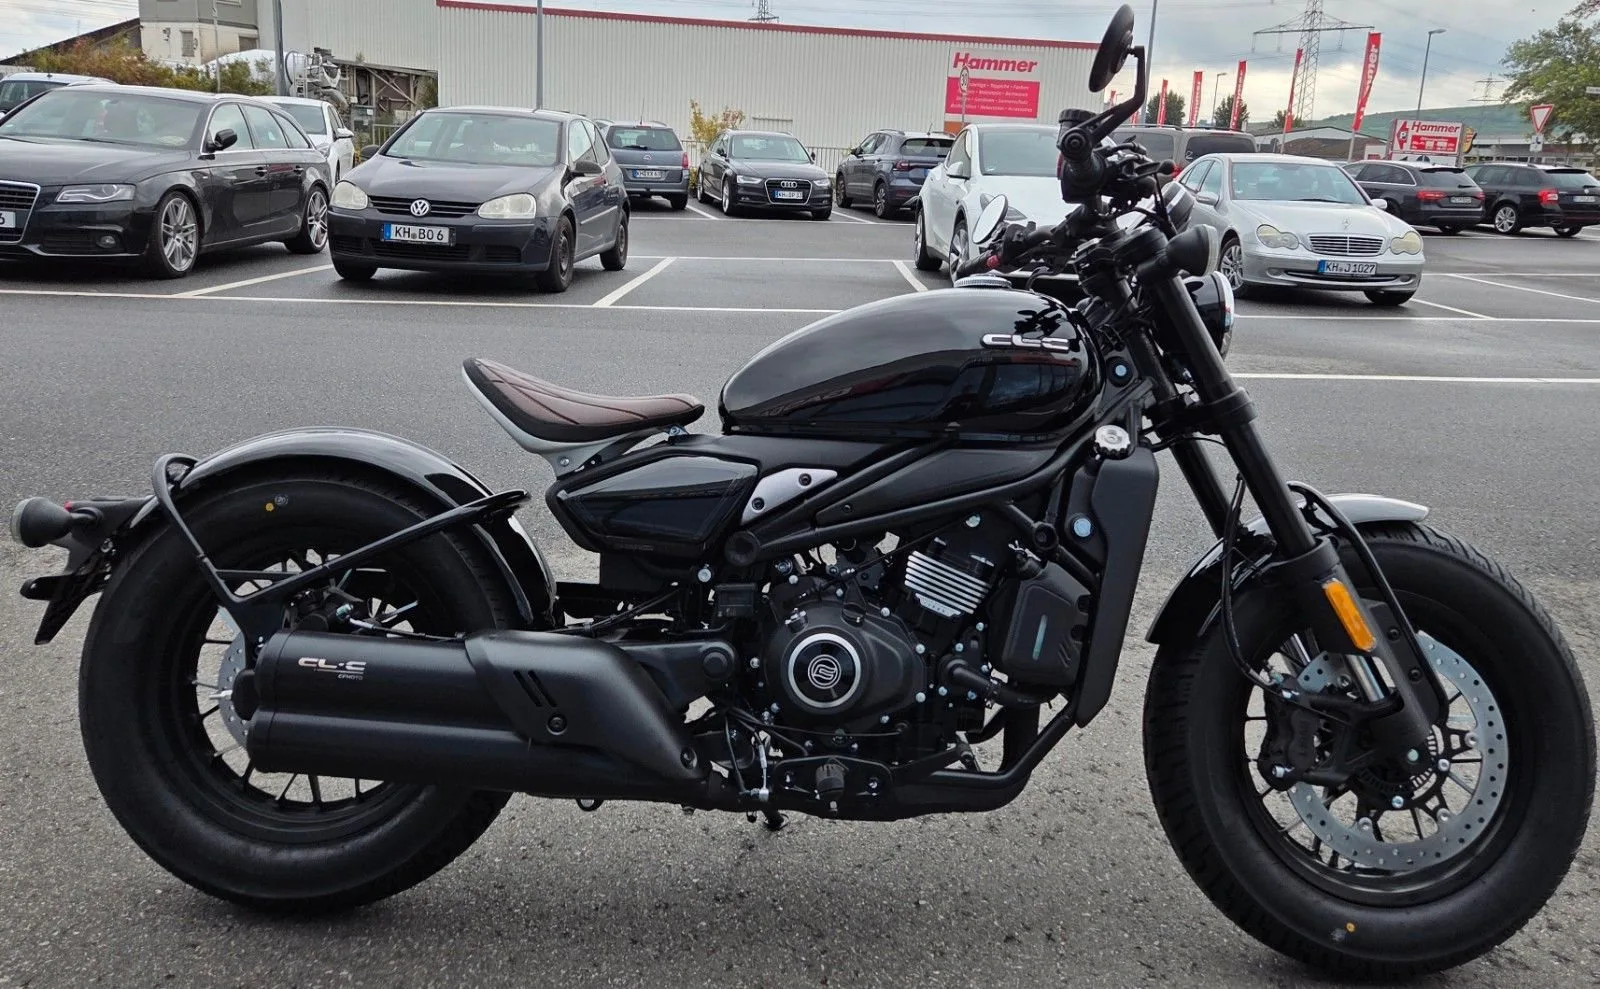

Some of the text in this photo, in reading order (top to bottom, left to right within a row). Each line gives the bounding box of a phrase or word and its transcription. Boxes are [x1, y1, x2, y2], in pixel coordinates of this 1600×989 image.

[953, 52, 1038, 73] Hammer
[1411, 121, 1460, 133] Hammer
[395, 226, 411, 239] KH
[1326, 262, 1339, 272] KH
